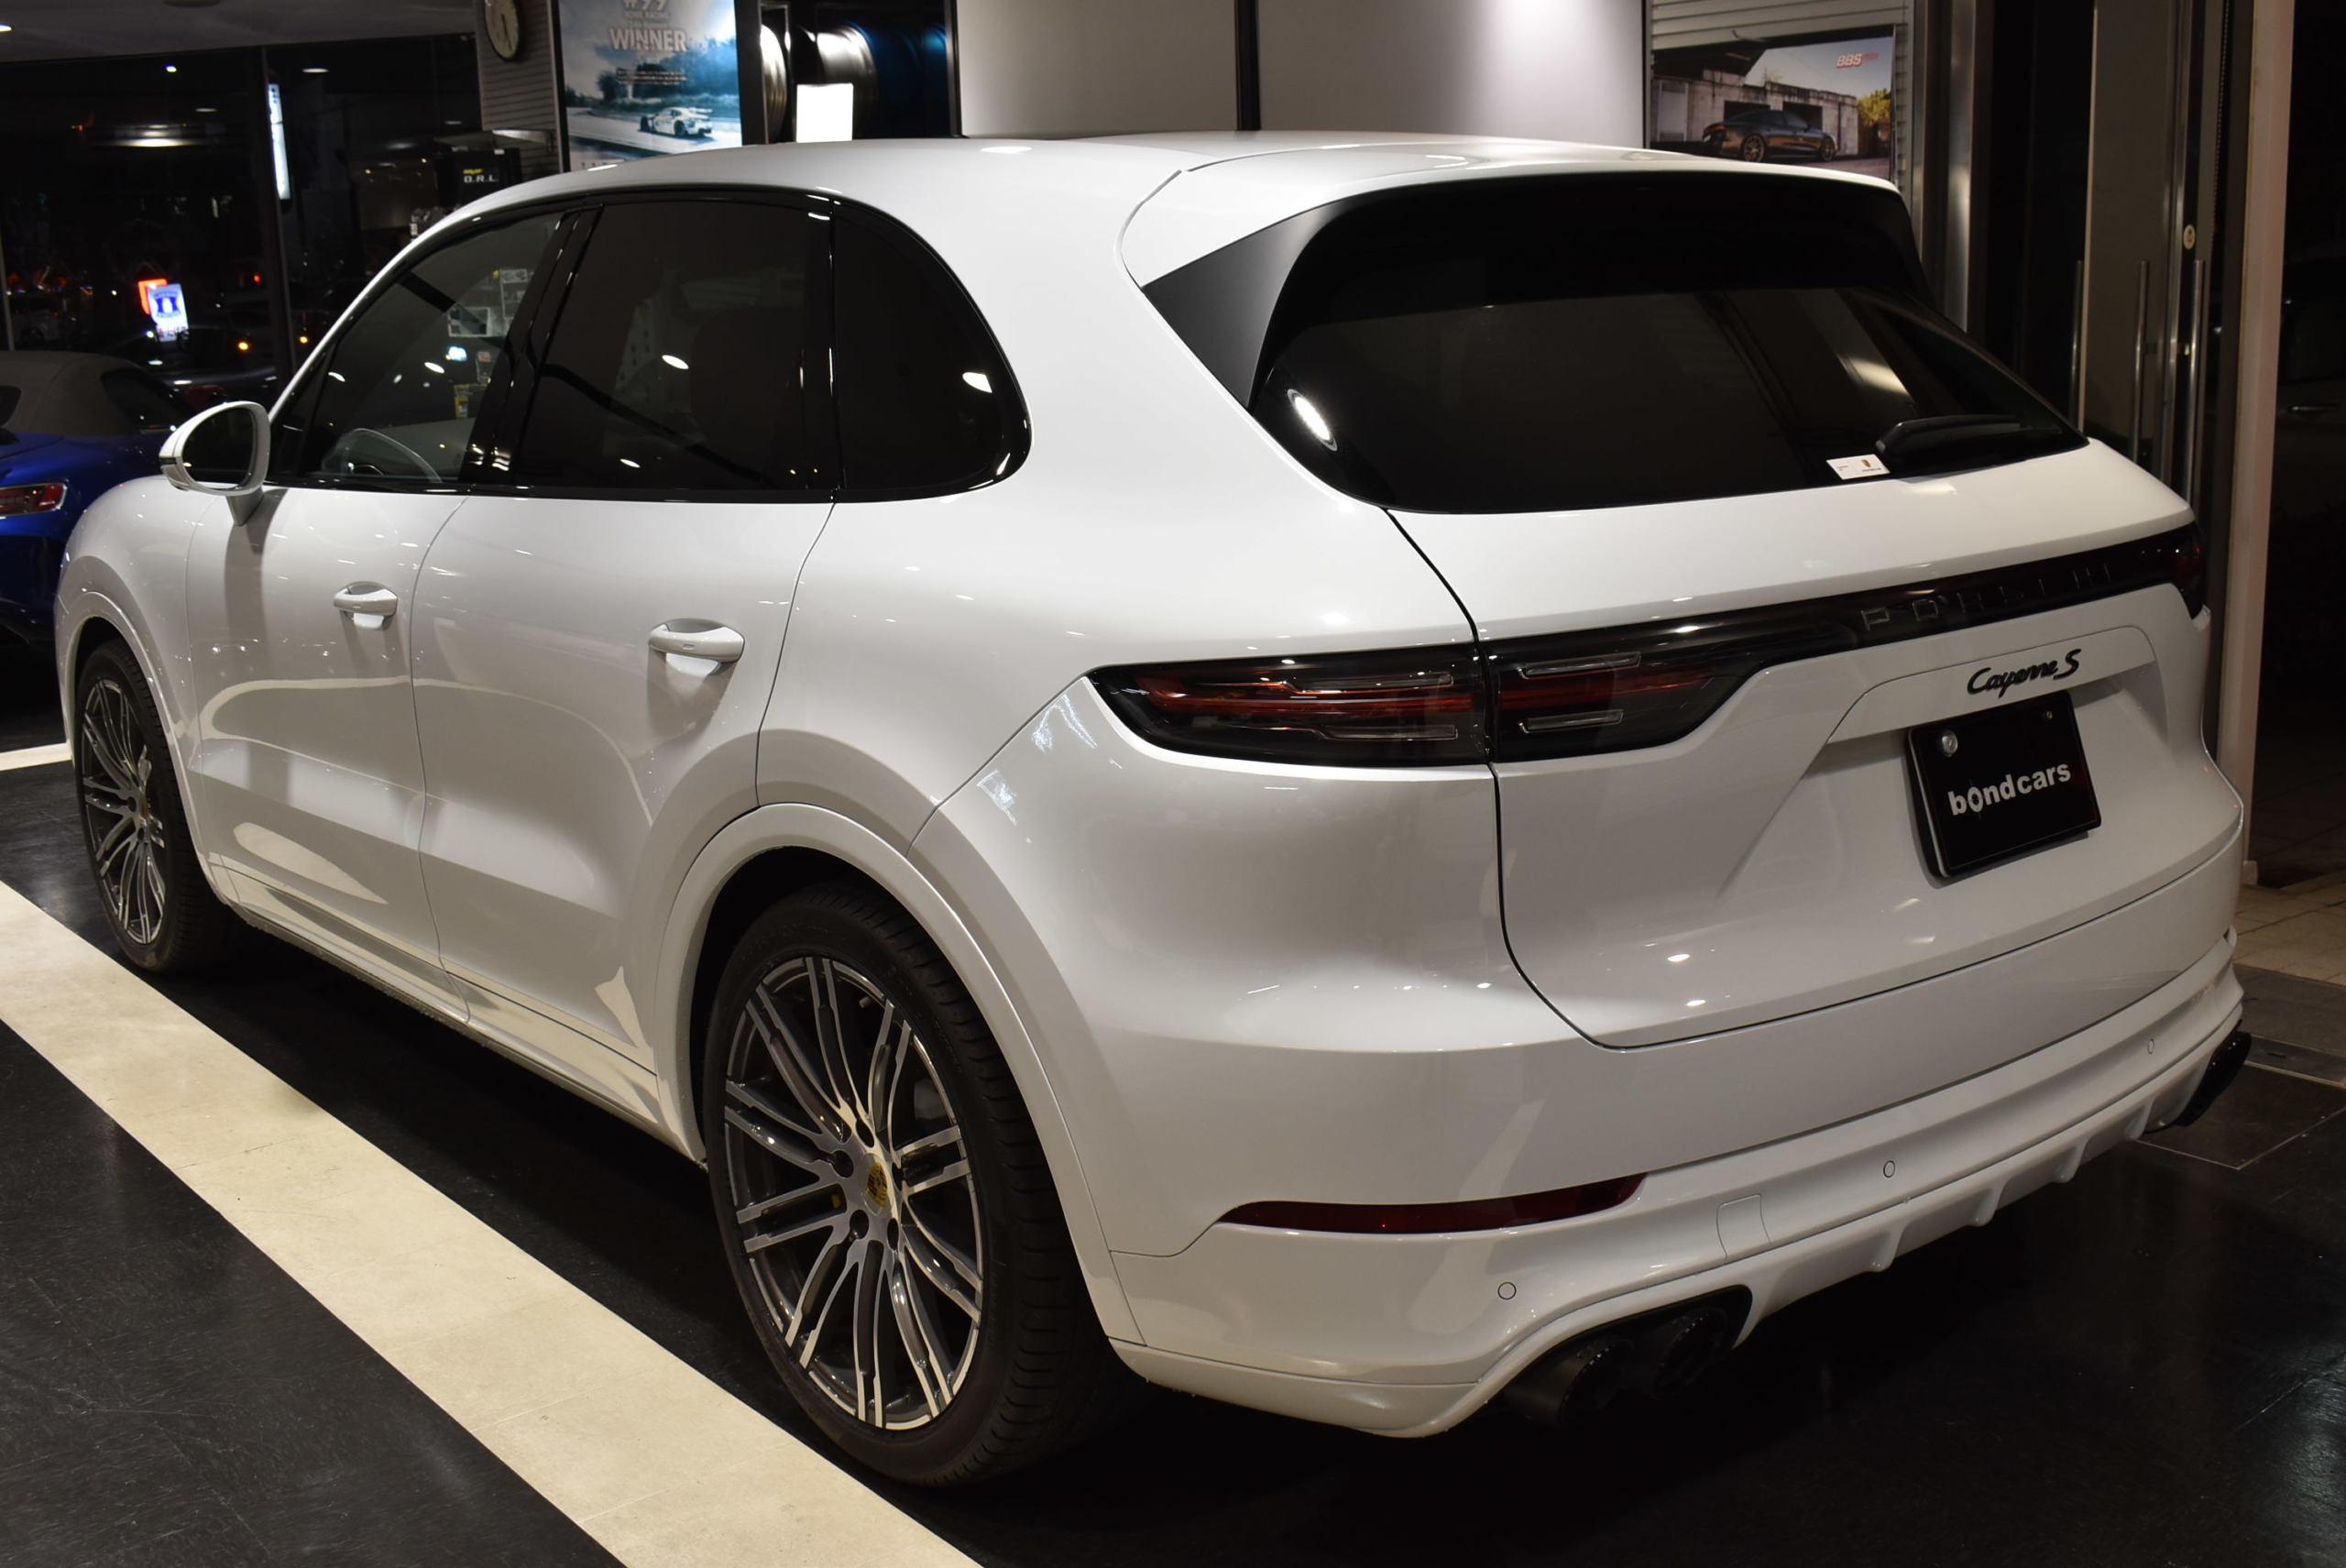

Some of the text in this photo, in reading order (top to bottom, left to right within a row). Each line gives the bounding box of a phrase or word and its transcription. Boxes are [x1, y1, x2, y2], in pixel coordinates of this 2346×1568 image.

[608, 27, 687, 51] WINNER
[1836, 53, 1864, 69] BBS
[1967, 648, 2082, 698] Cayenne S
